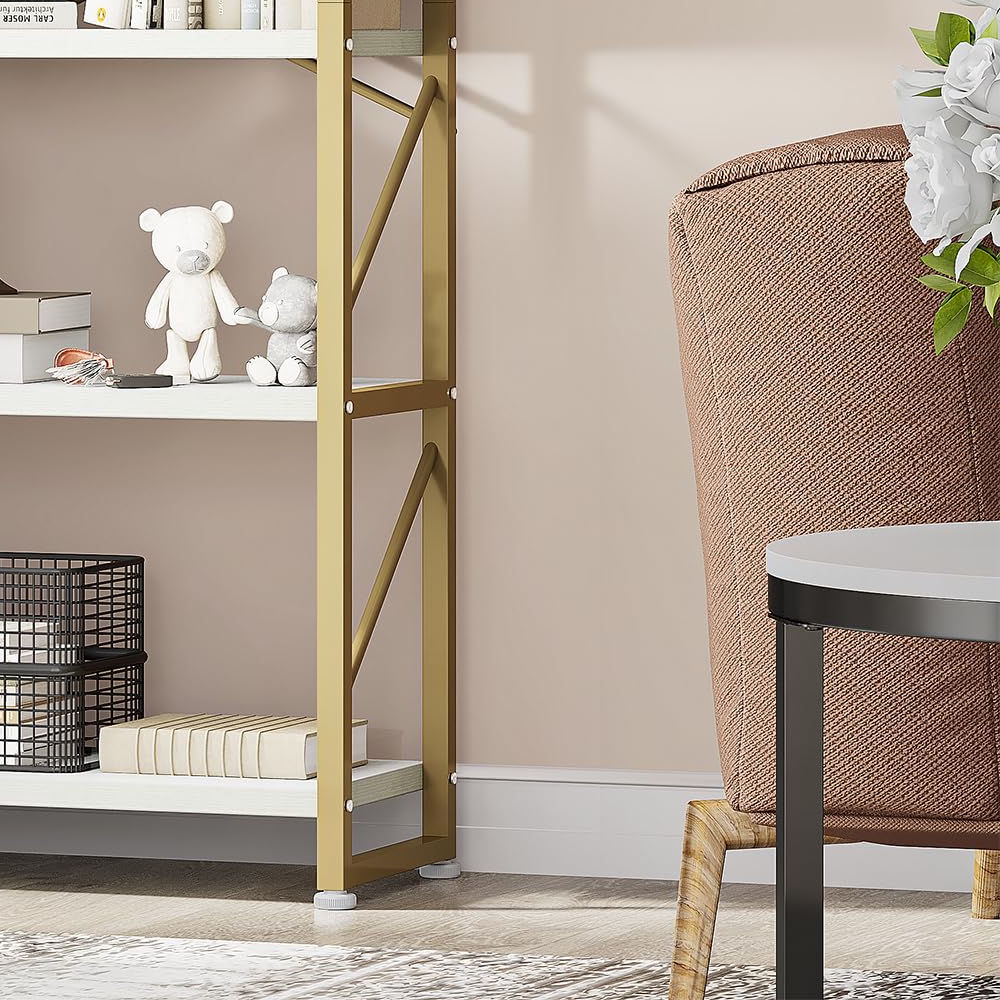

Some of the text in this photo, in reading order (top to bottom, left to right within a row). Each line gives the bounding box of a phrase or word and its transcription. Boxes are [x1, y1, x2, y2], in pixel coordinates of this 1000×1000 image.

[12, 6, 54, 14] Architektur
[3, 15, 54, 23] CARL MOSER
